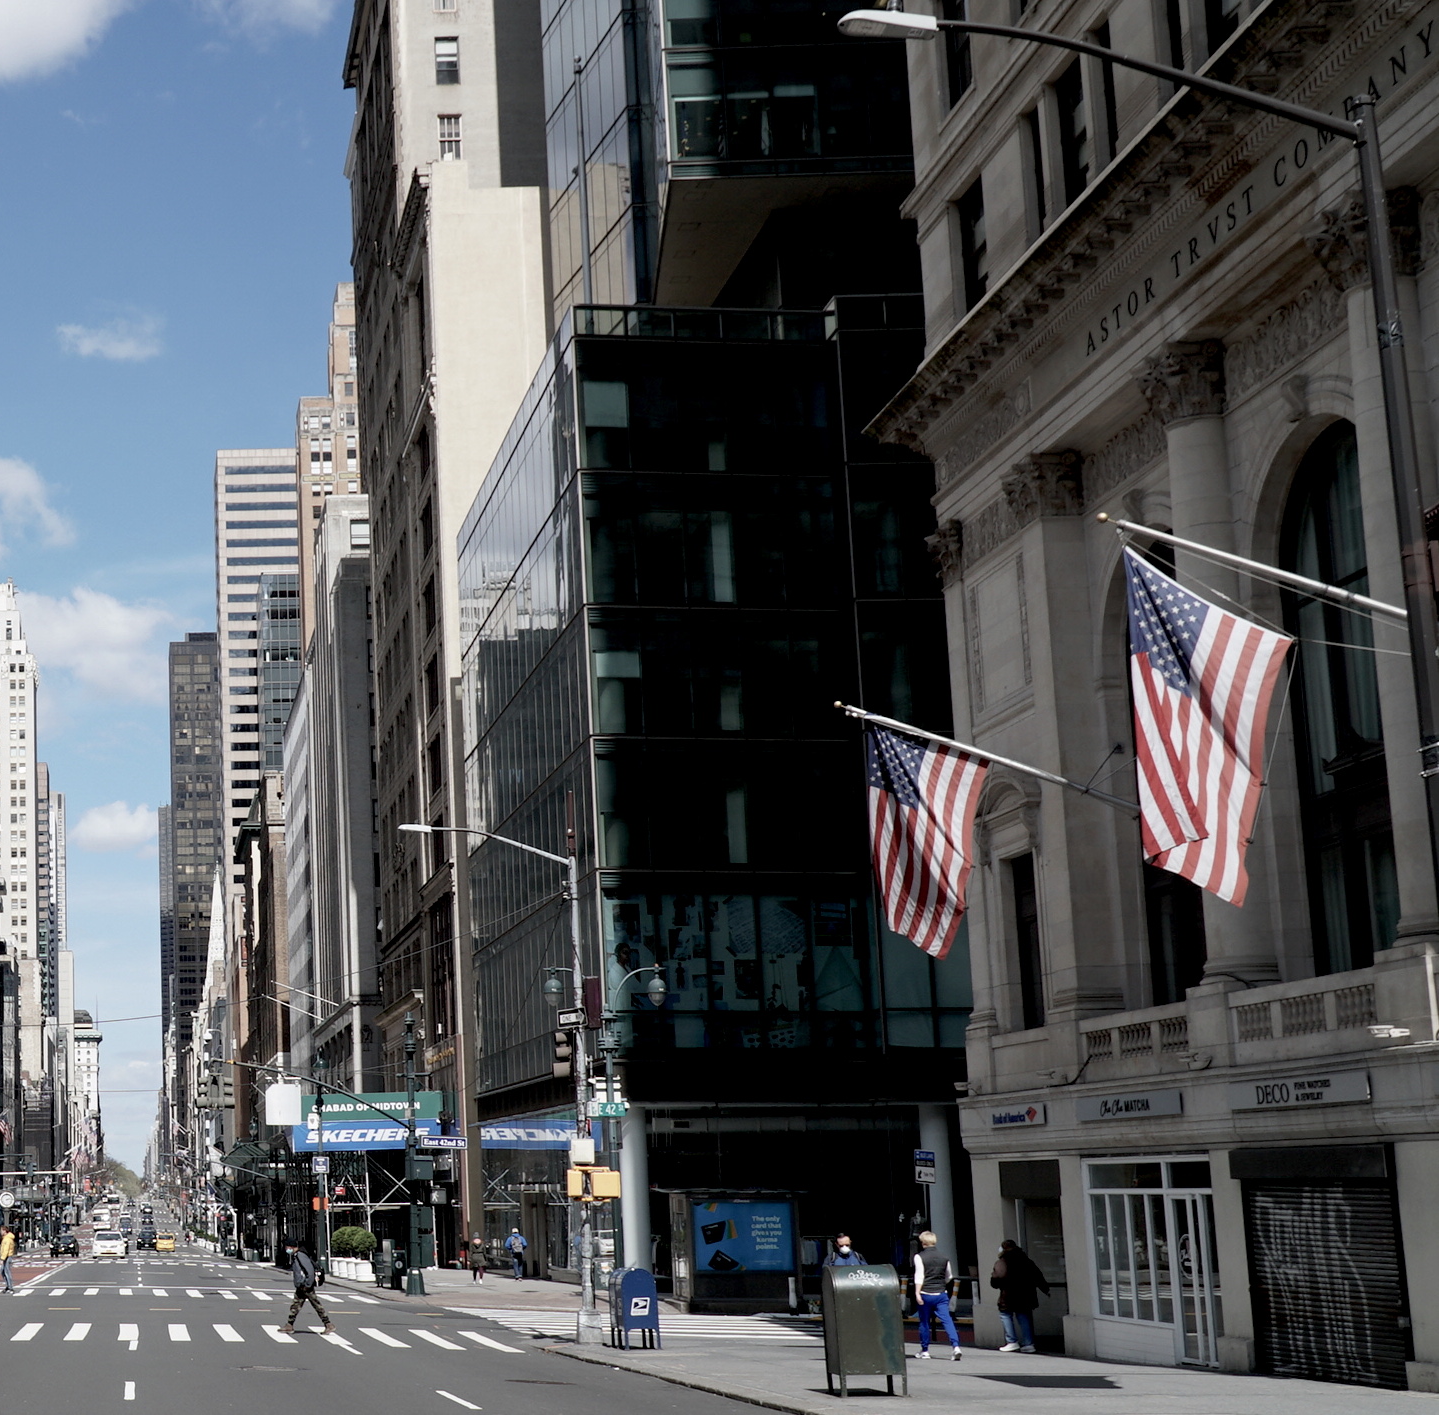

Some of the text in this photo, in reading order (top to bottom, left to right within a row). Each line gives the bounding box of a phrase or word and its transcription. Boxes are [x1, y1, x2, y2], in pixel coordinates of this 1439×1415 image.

[1086, 277, 1155, 356] ASTOR
[1170, 185, 1254, 278] TRVST
[1255, 1083, 1290, 1105] DECO
[311, 1102, 354, 1113] CHABAD
[371, 1101, 421, 1111] MIDTOWN
[598, 1104, 603, 1114] E
[605, 1104, 616, 1115] 42
[1124, 1098, 1150, 1113] MATCHA
[423, 1138, 465, 1147] East 42nd St
[765, 1215, 780, 1223] only
[751, 1229, 769, 1237] gives
[755, 1243, 779, 1251] points.
